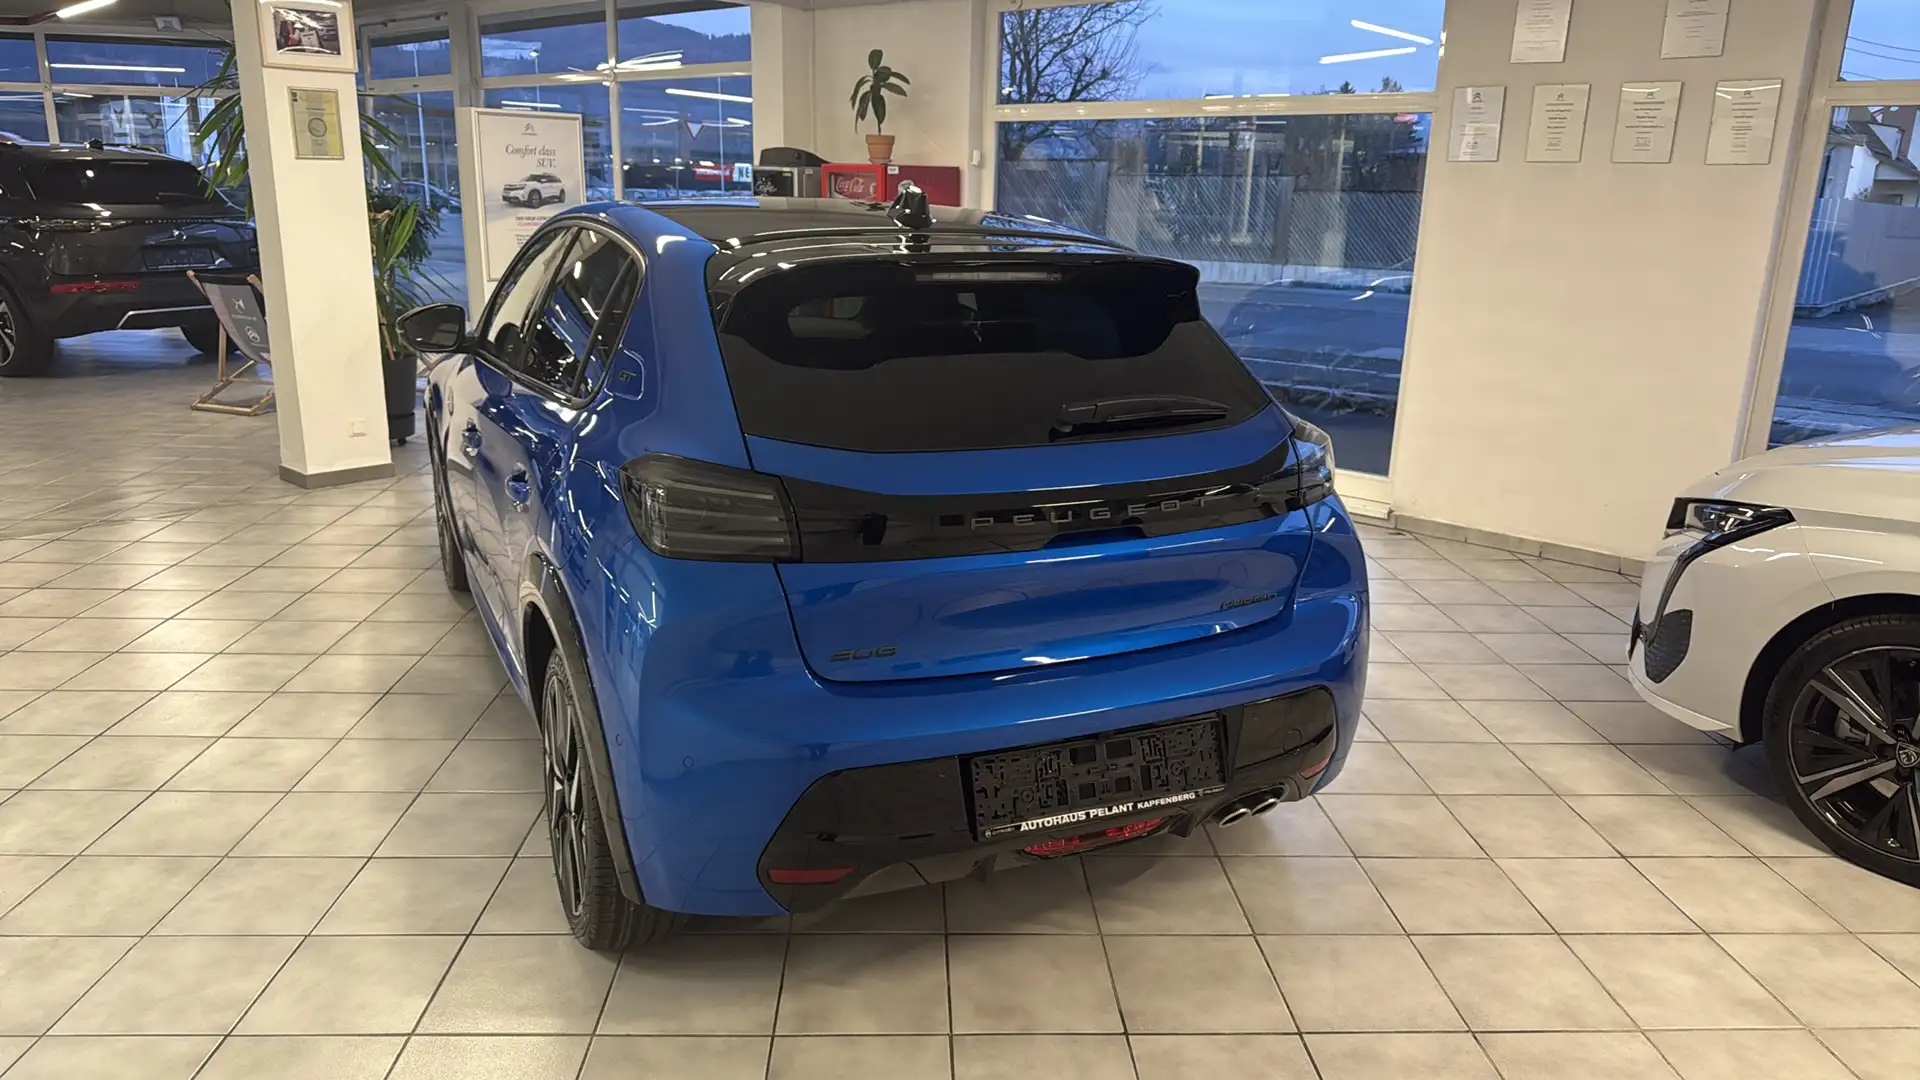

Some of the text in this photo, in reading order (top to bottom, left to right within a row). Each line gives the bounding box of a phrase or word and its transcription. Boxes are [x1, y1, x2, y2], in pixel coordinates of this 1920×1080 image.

[505, 144, 556, 159] Comfort class
[970, 497, 1205, 530] PEUGEOT
[1020, 792, 1196, 832] AUTOHAUS PELANT KAPFENBERG
